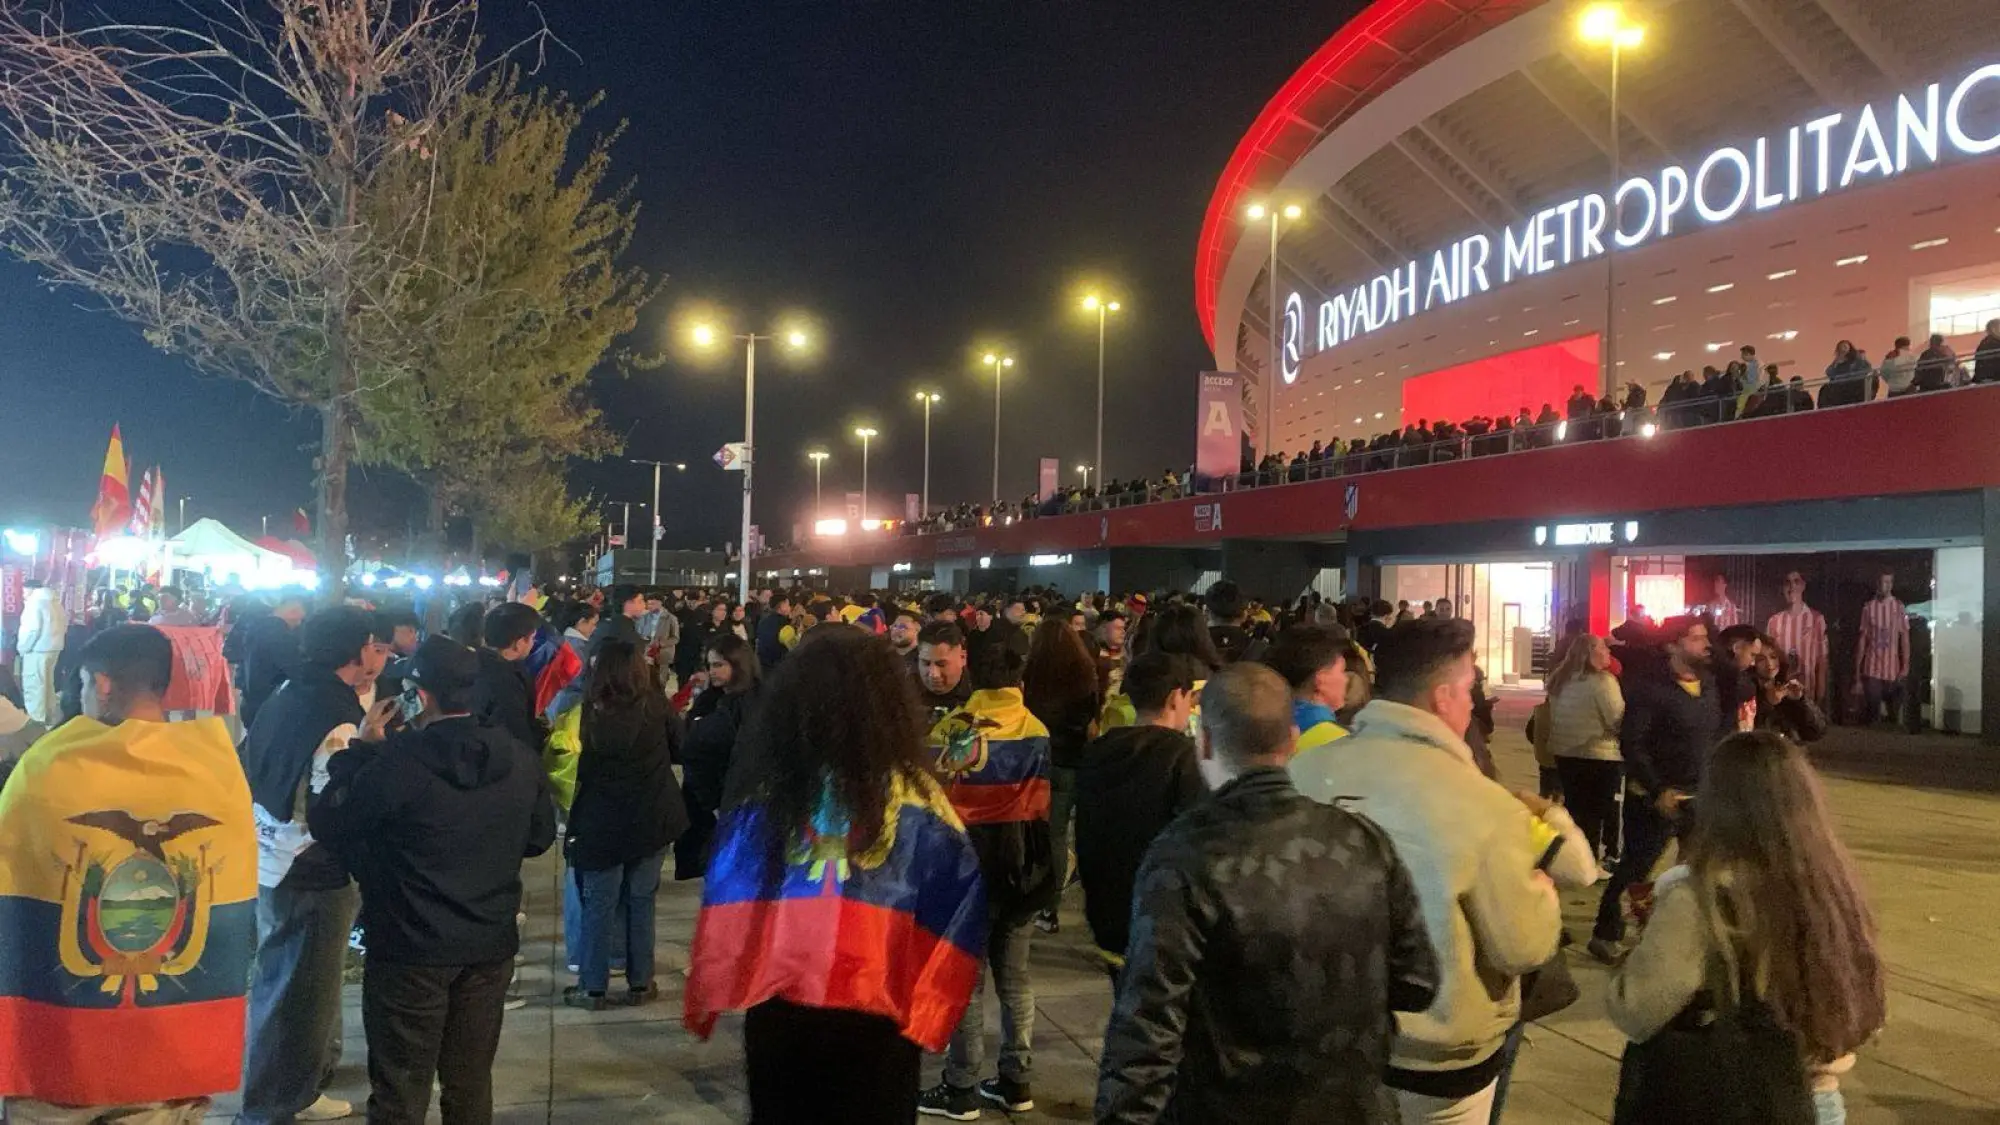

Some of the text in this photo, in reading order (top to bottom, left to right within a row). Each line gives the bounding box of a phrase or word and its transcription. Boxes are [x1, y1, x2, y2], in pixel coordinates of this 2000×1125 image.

[1318, 64, 2000, 353] RIYADH AIR METROPOLITANO
[1203, 401, 1234, 437] A
[1211, 503, 1222, 531] A
